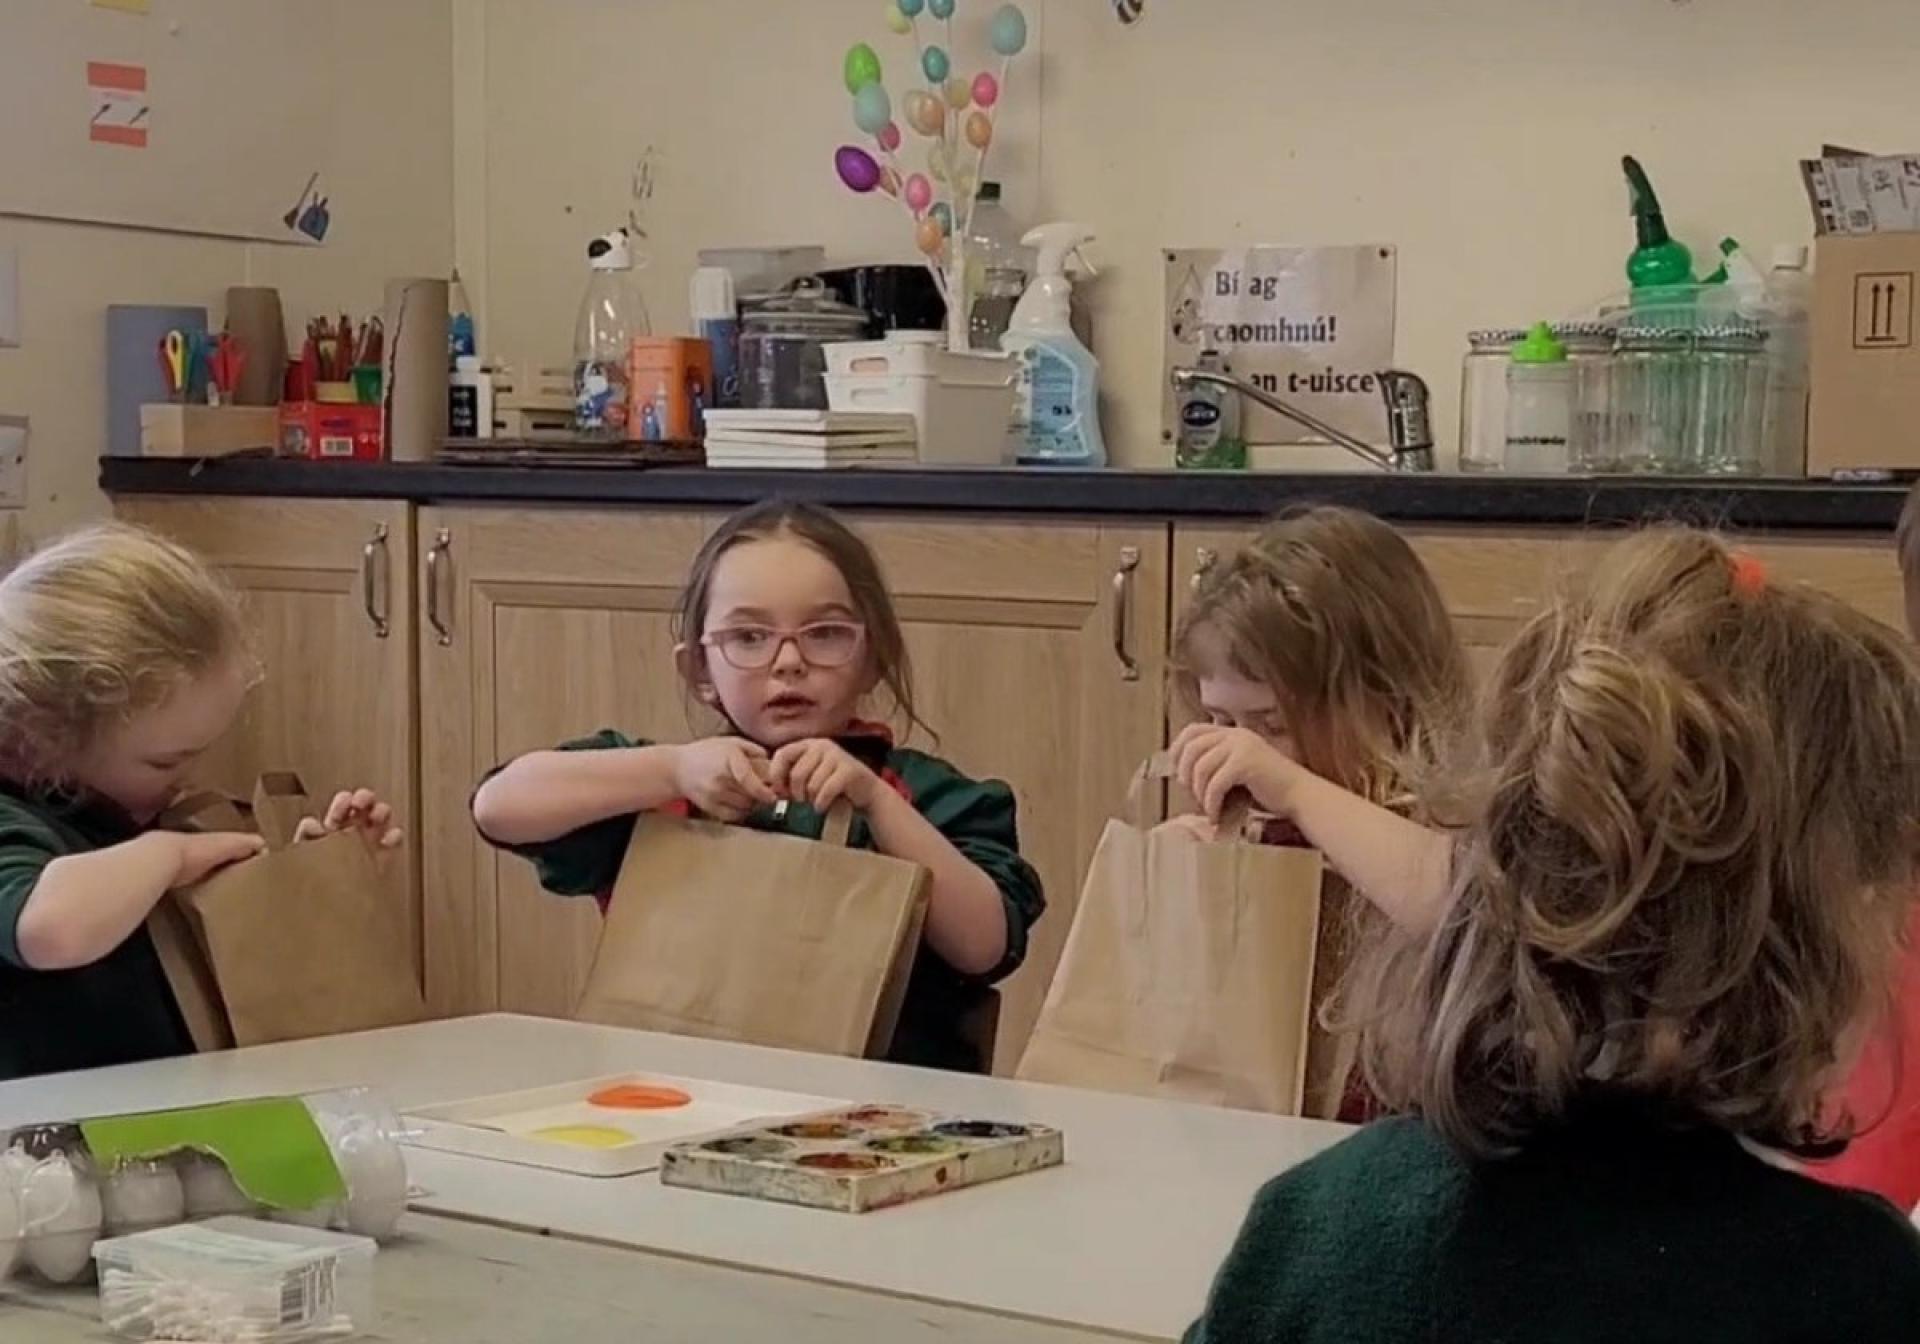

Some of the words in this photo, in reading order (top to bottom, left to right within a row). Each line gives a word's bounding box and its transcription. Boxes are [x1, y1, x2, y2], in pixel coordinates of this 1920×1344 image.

[1215, 271, 1240, 296] Bí
[1249, 276, 1278, 301] ag
[1213, 315, 1337, 343] caomhnú!
[1288, 366, 1374, 393] t-uisce
